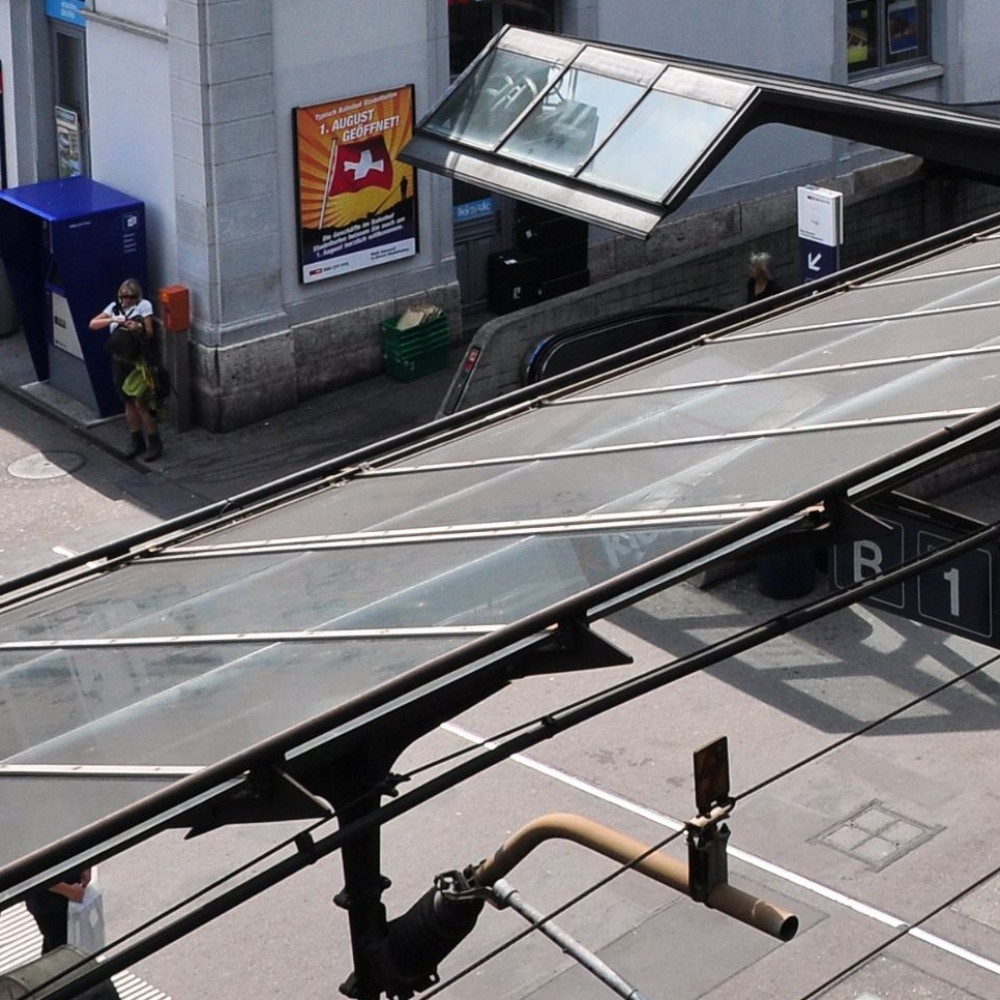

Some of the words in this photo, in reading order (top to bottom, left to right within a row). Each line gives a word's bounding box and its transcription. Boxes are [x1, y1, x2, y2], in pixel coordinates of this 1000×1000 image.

[320, 123, 330, 136] 1.
[331, 109, 375, 133] AUGUST
[342, 115, 400, 142] GEÖFFNET!
[853, 539, 883, 583] B
[943, 567, 960, 617] 1
